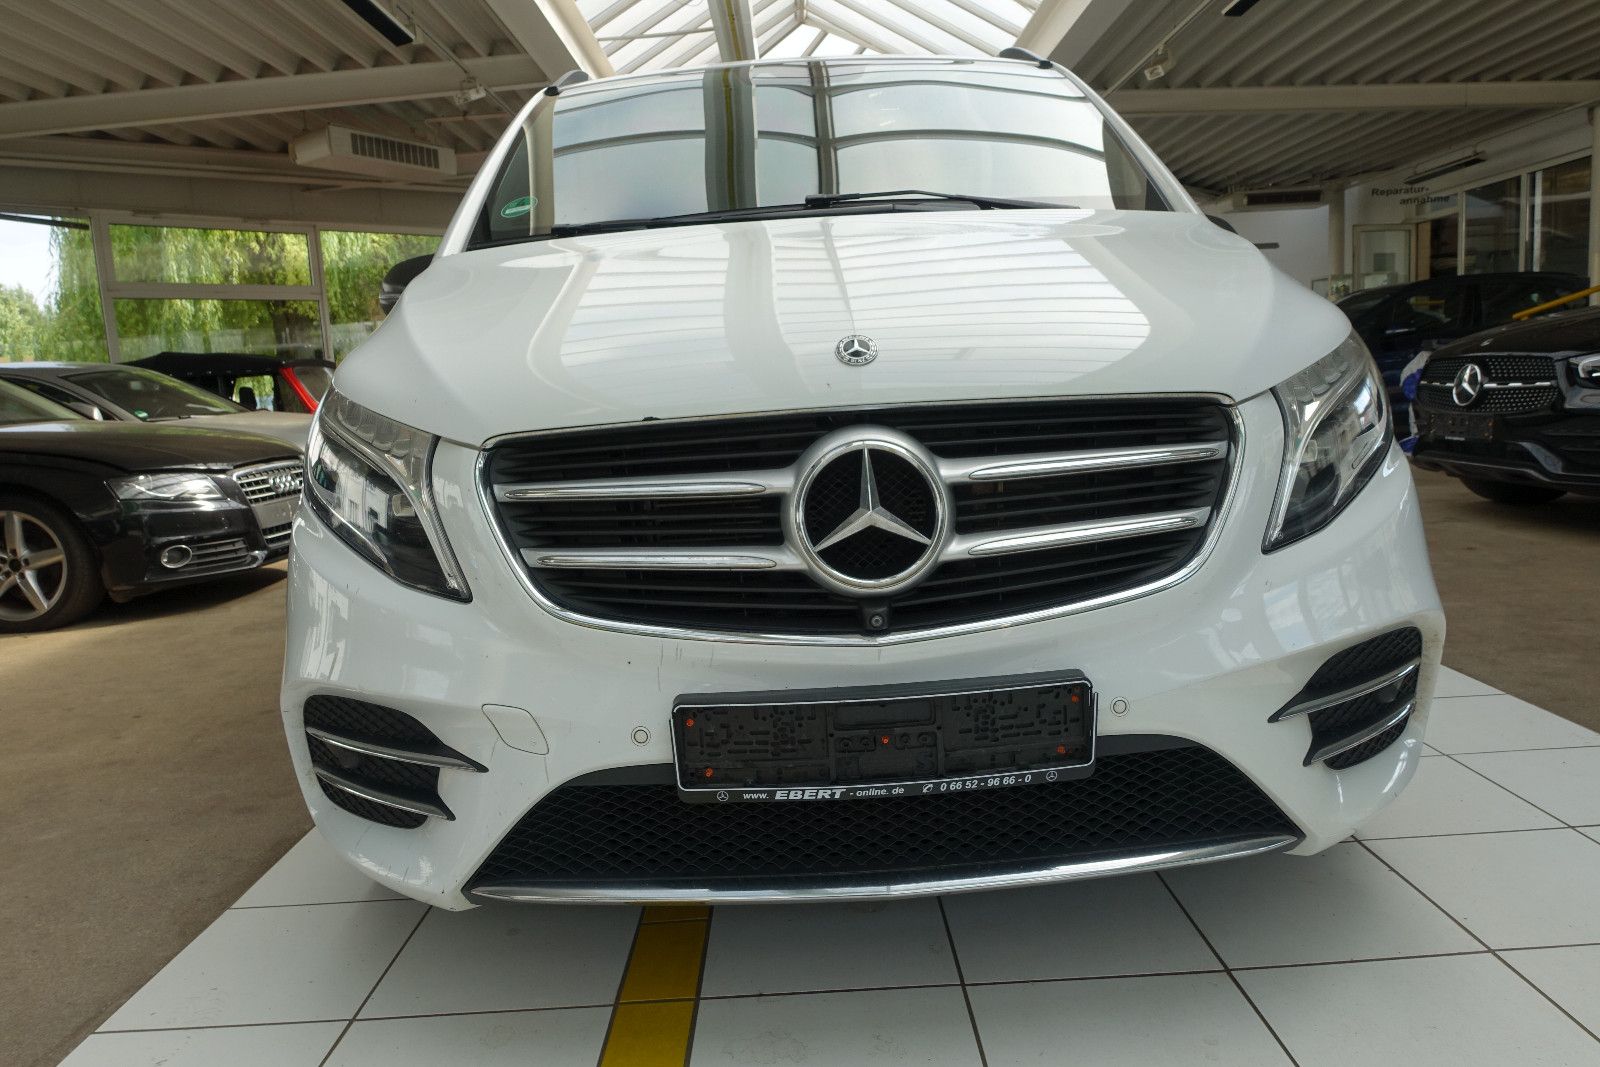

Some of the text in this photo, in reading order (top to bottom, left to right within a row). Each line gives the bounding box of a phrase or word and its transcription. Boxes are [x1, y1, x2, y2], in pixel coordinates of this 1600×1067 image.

[743, 791, 769, 799] www.
[775, 789, 846, 799] EBERT
[940, 783, 947, 791] 0
[950, 782, 962, 790] 66
[965, 780, 978, 789] 52
[988, 778, 1000, 787] 96
[1024, 774, 1032, 783] 0
